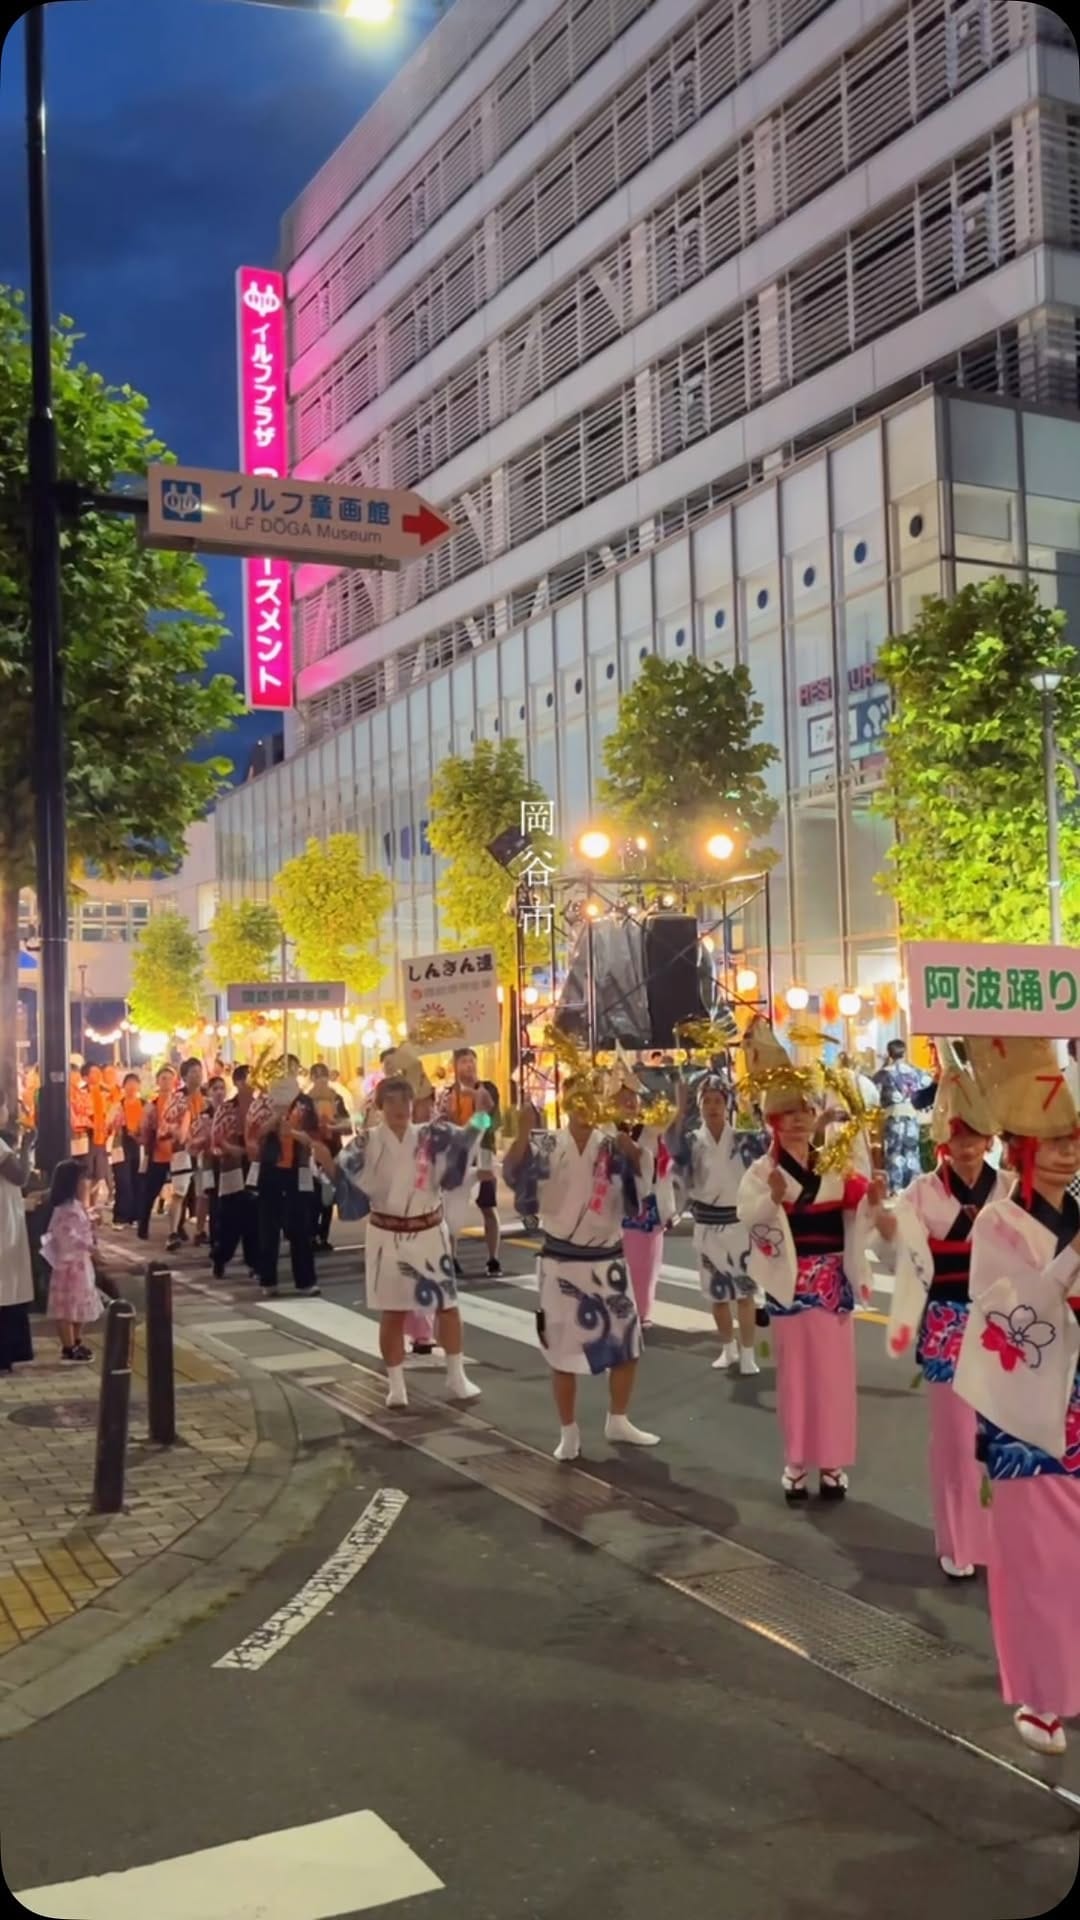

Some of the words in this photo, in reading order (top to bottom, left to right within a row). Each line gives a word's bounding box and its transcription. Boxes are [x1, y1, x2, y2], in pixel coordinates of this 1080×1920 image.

[251, 322, 277, 447] イルフプラザ
[220, 485, 391, 526] イルフ童画館
[230, 516, 255, 531] ILF
[260, 517, 312, 537] DŌGA
[317, 523, 382, 544] Museum
[924, 965, 1078, 1012] 阿波踊り
